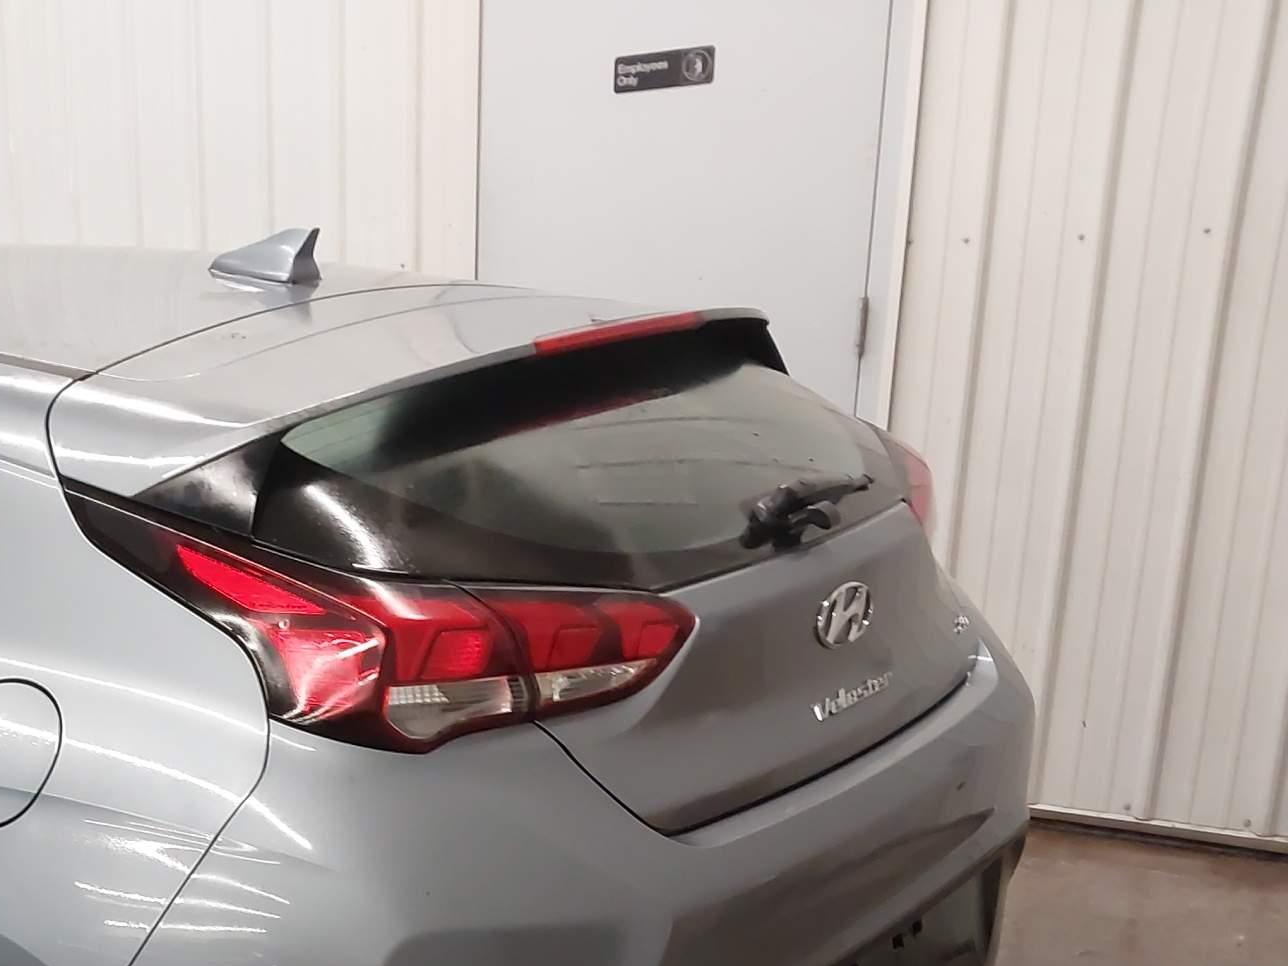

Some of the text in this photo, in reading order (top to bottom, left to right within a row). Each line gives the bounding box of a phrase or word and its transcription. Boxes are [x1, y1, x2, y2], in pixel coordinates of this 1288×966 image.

[617, 61, 669, 75] Employees
[617, 75, 639, 87] Only
[810, 671, 893, 722] Veloster
